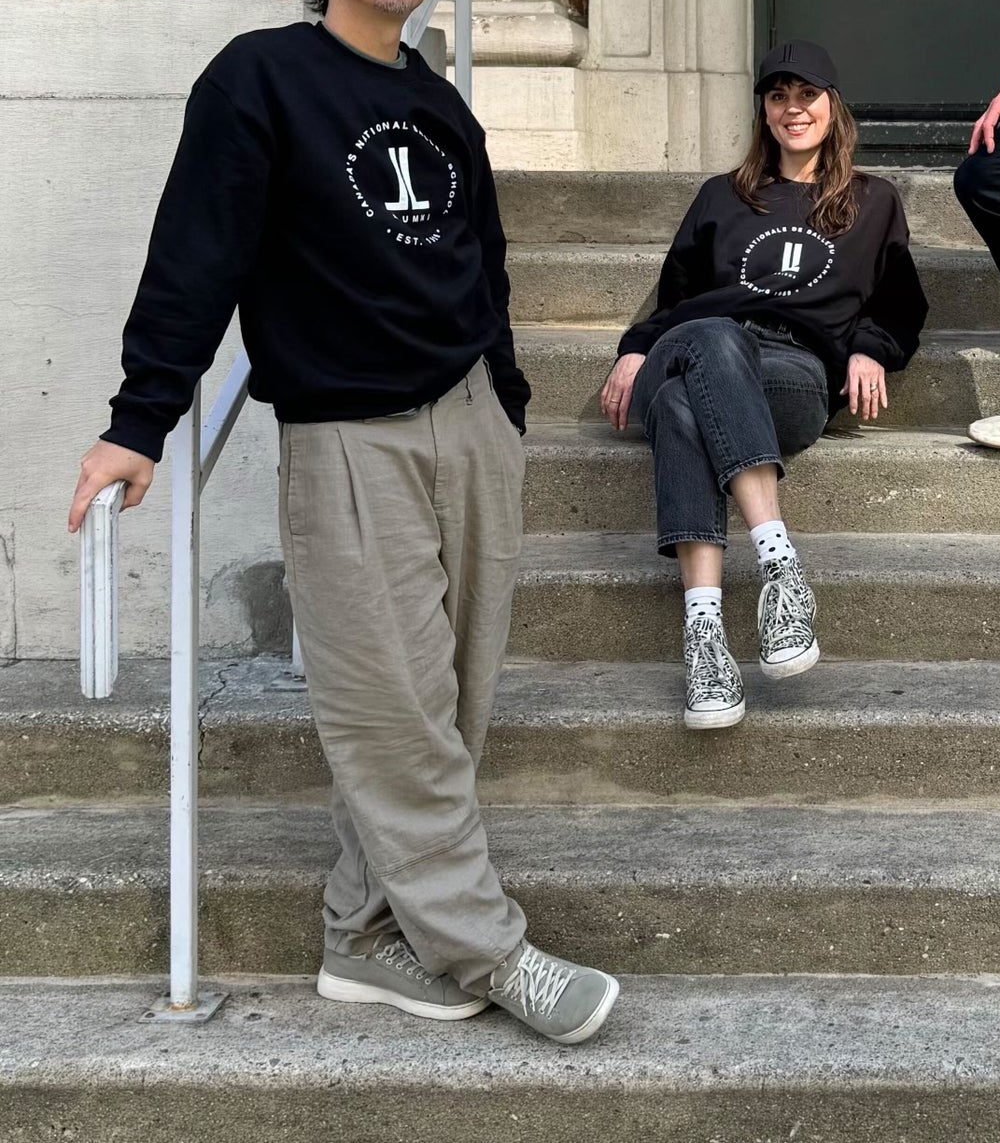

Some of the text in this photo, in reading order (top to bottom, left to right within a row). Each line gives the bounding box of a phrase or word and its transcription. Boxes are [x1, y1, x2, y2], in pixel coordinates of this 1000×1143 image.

[355, 121, 409, 150] NATIONAL
[395, 232, 423, 246] EST.
[745, 226, 787, 254] NATIONALE
